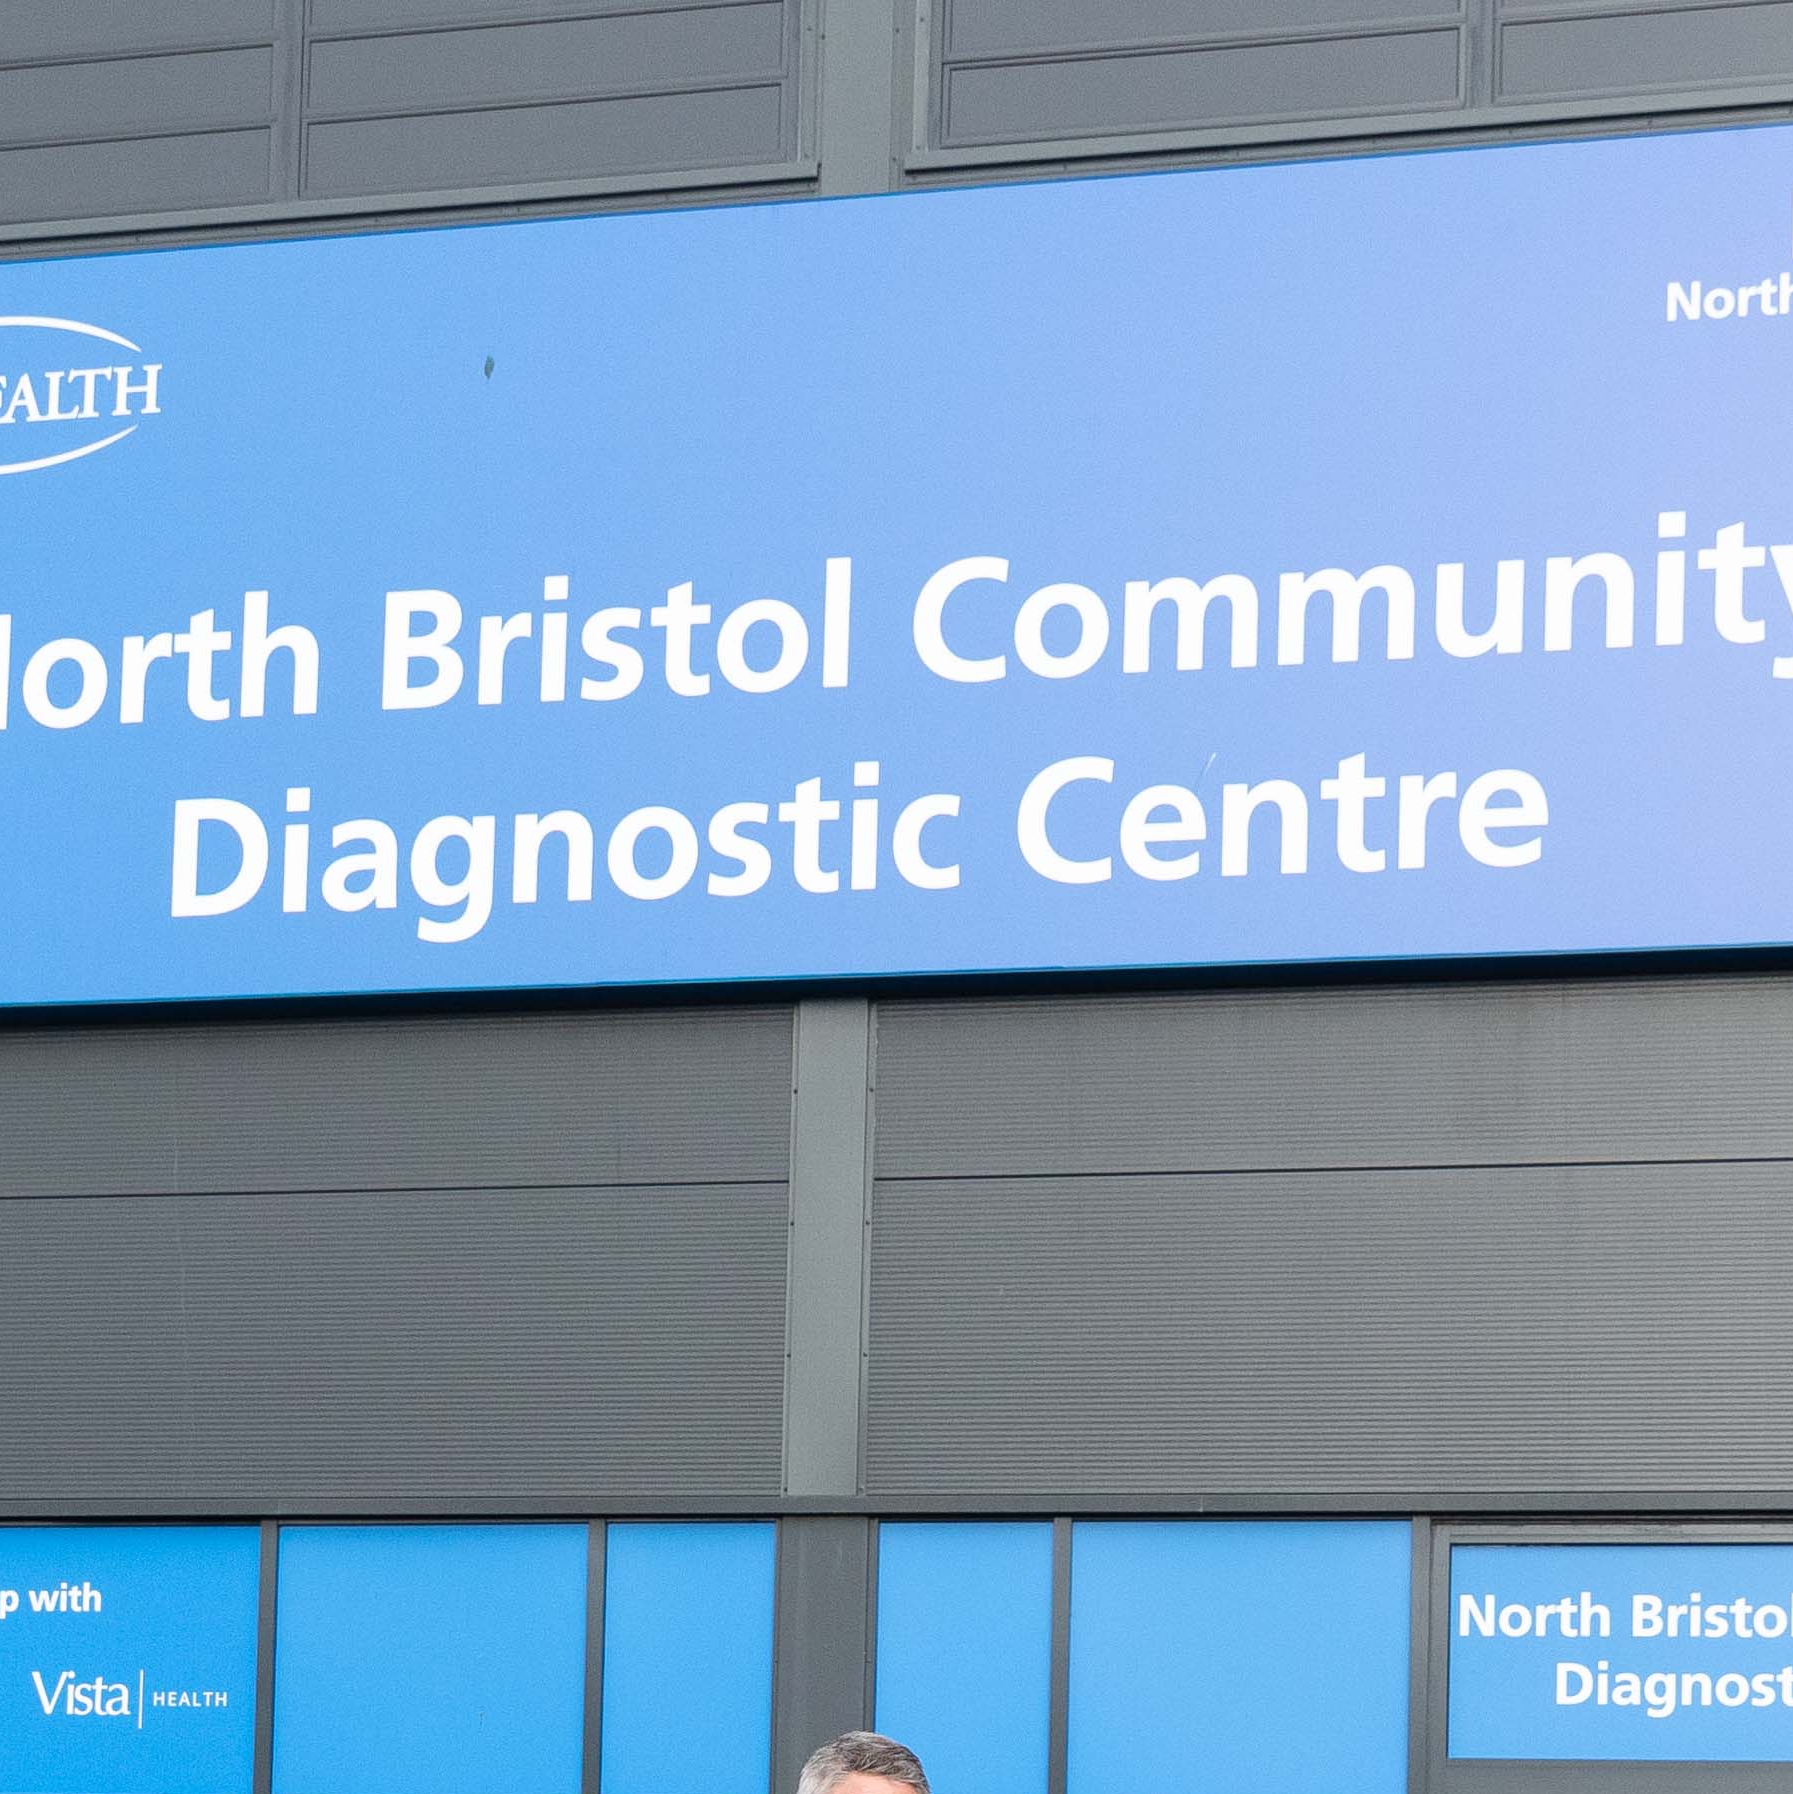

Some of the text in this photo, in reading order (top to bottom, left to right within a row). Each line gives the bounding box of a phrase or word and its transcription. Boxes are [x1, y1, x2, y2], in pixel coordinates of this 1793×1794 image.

[381, 556, 852, 710] Bristol
[171, 752, 1549, 944] Diagnostic Centre
[28, 1581, 102, 1613] with
[1459, 1591, 1611, 1638] North
[31, 1670, 228, 1716] Vista HEALTH
